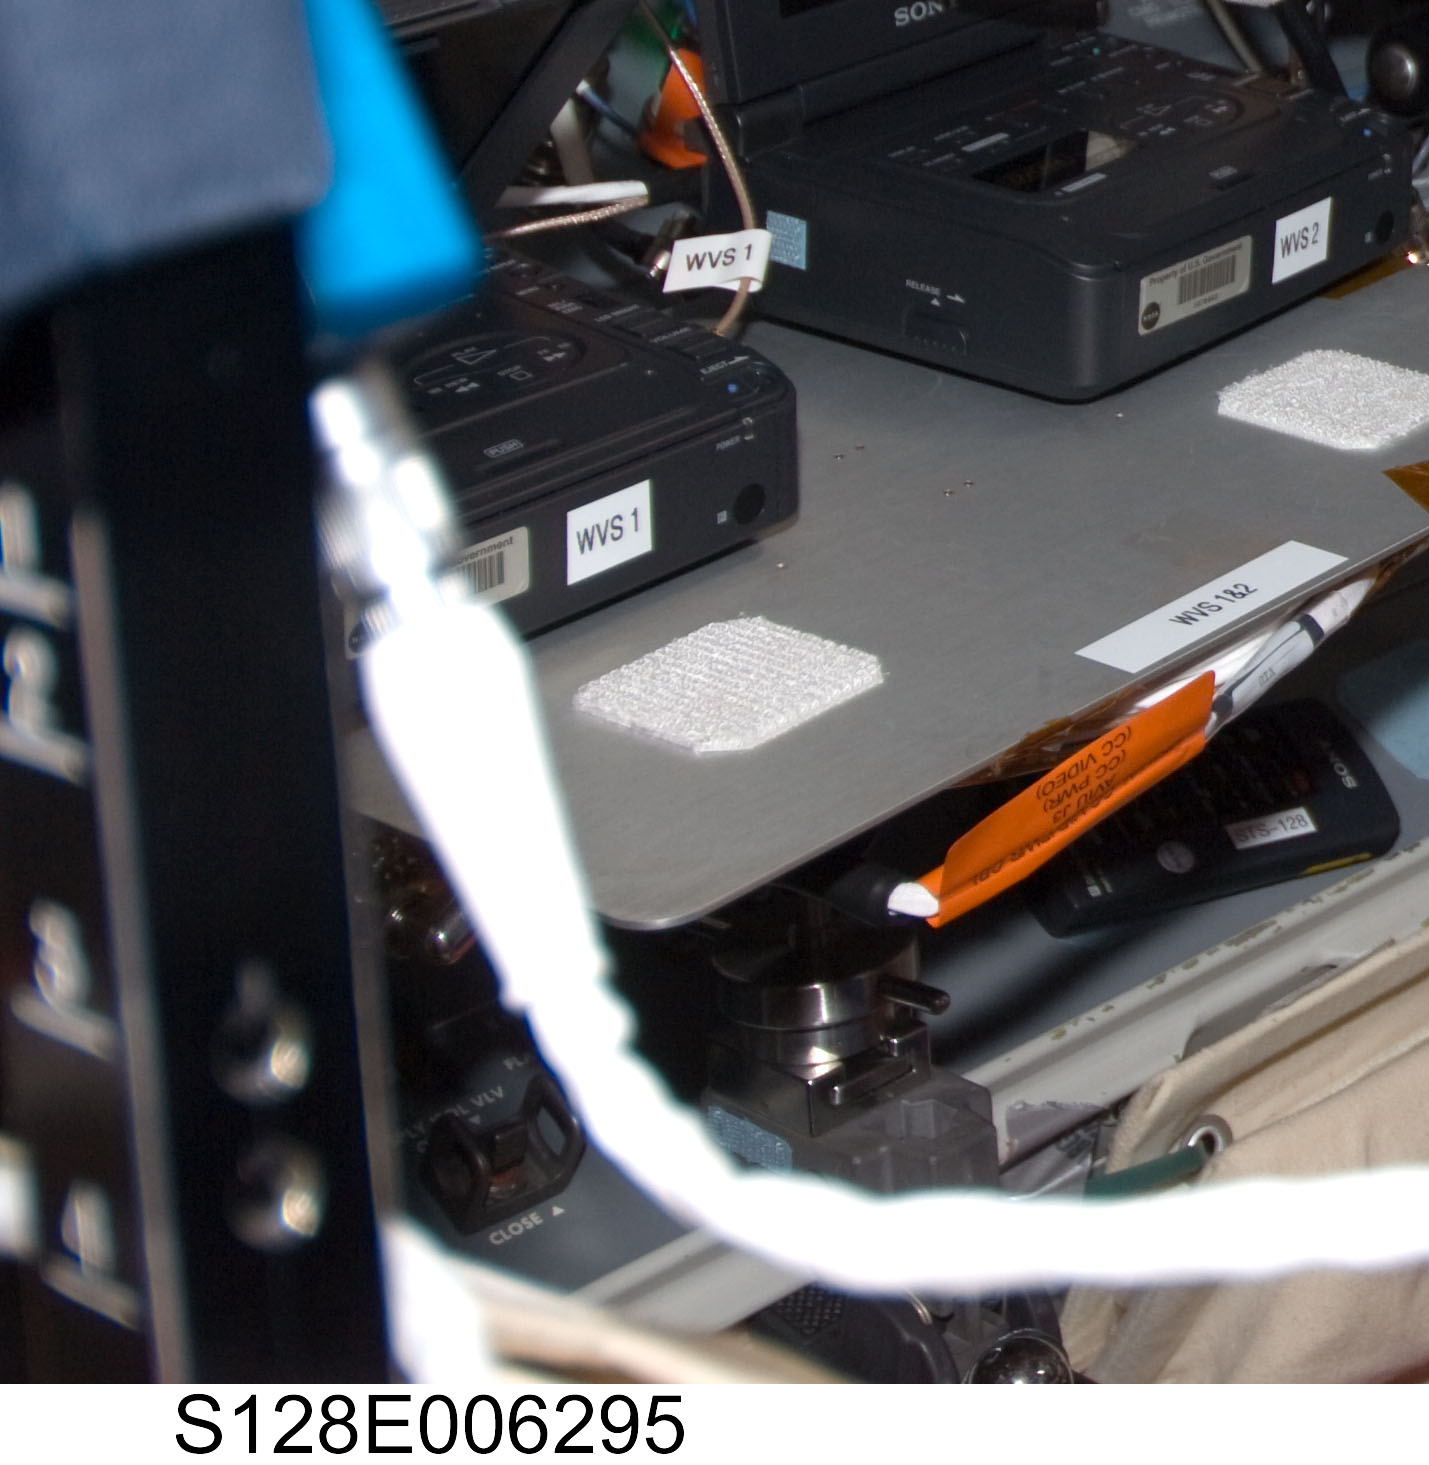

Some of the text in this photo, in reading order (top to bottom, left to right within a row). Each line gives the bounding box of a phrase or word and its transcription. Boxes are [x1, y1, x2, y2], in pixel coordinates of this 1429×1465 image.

[1279, 221, 1321, 259] WVS 2
[684, 243, 754, 272] WVS 1
[905, 277, 942, 298] RELEASE
[1148, 266, 1179, 287] Property
[700, 360, 729, 376] EJECT
[575, 506, 640, 556] WVS 1
[1167, 582, 1259, 628] WVS 1&2
[1035, 724, 1133, 801] (CC VIDEO)
[1042, 749, 1127, 815] (CC PWR)
[1237, 813, 1310, 844] STS-128
[469, 1085, 506, 1108] VLV
[489, 1210, 544, 1246] CLOSE
